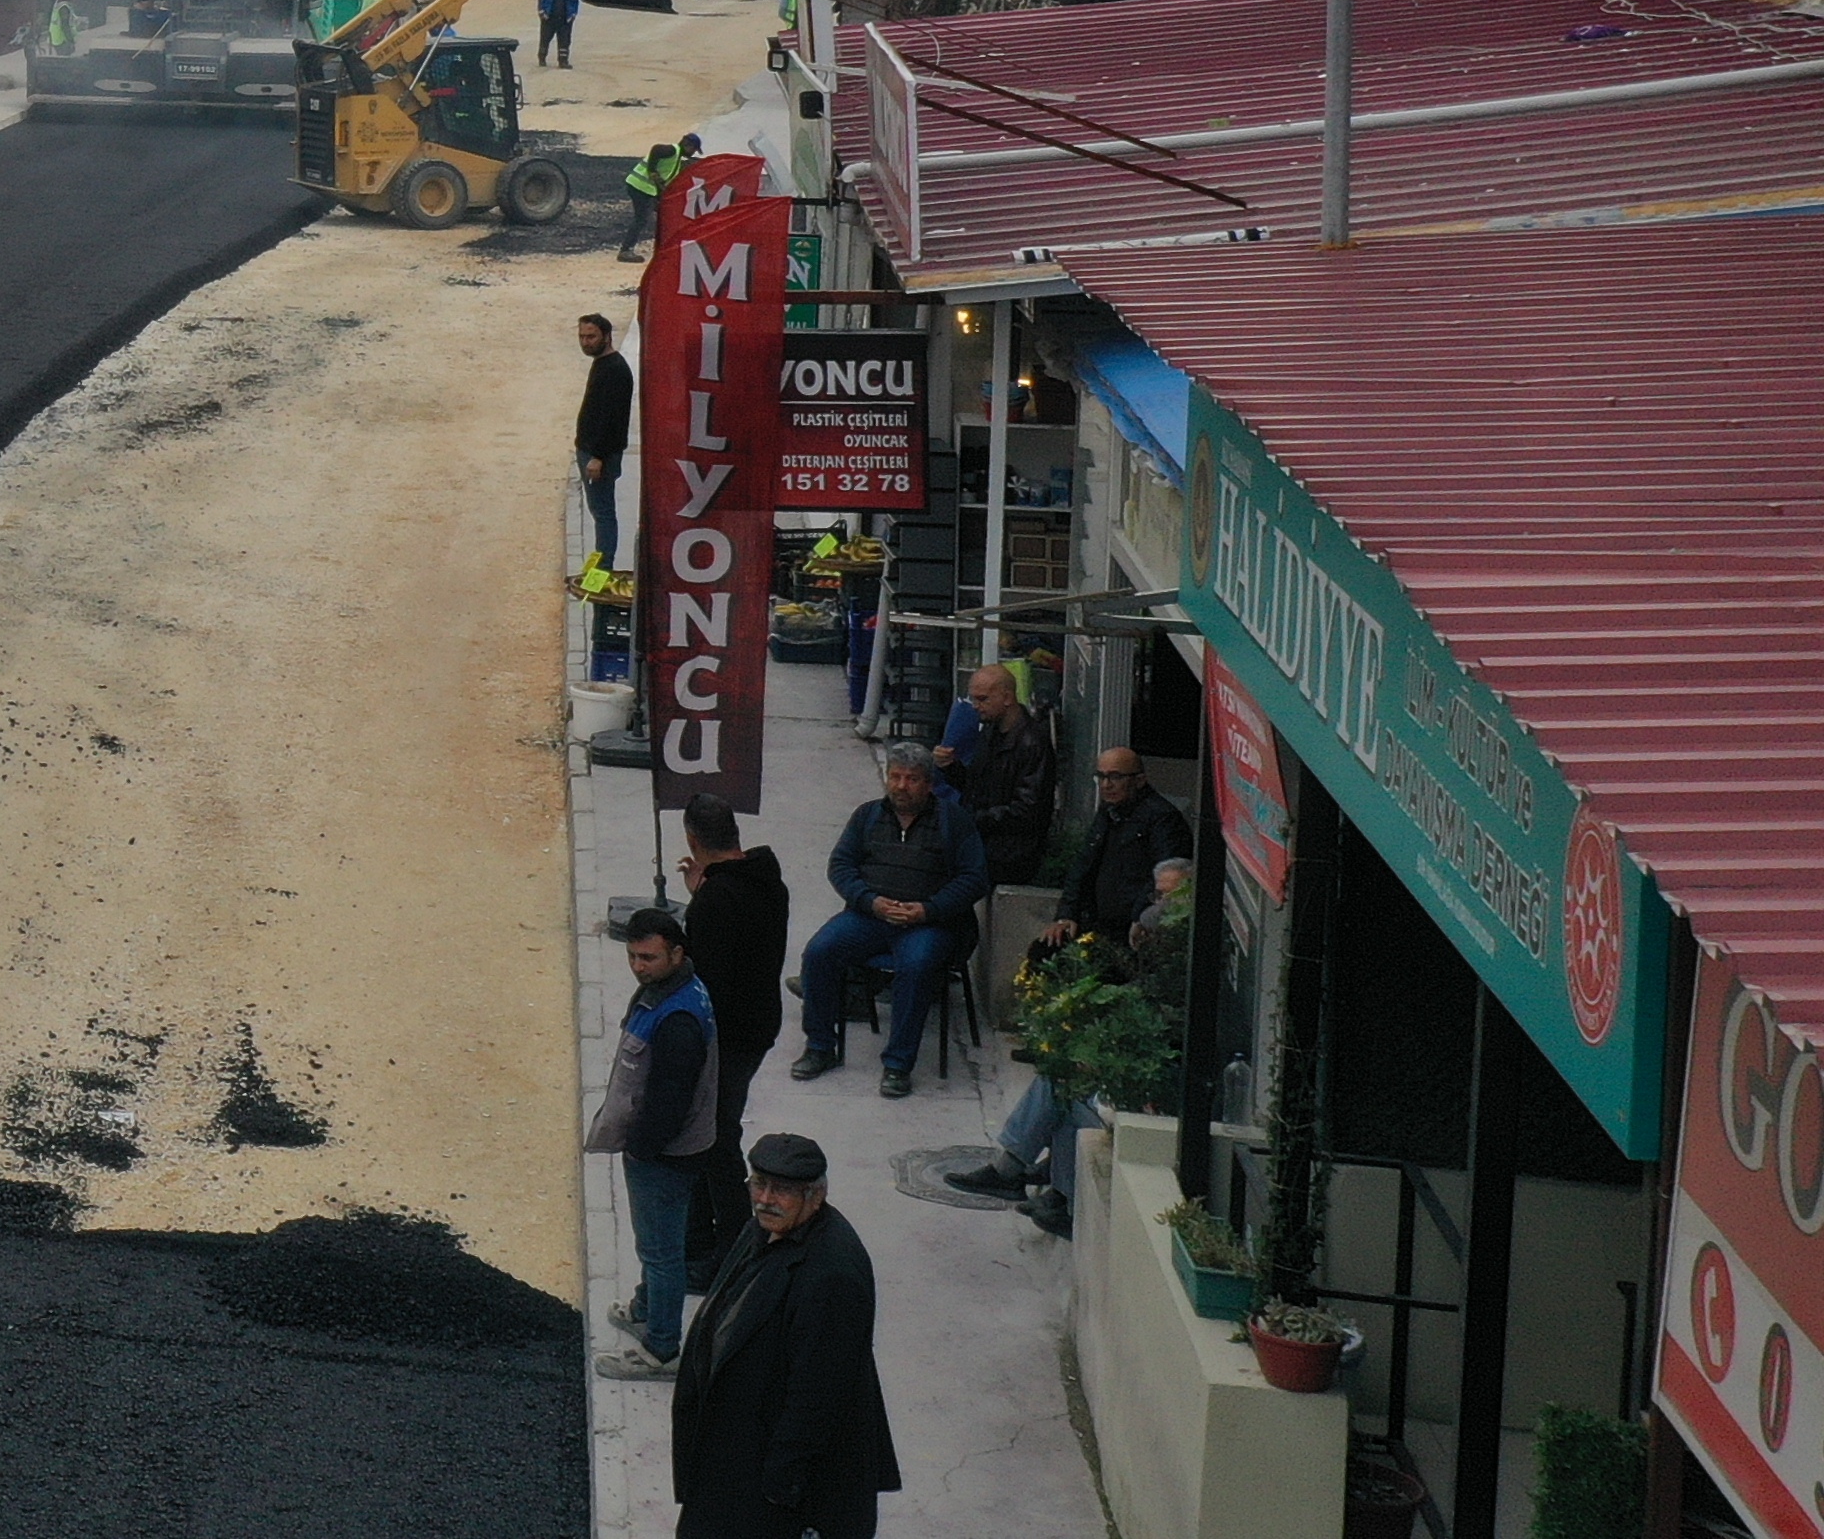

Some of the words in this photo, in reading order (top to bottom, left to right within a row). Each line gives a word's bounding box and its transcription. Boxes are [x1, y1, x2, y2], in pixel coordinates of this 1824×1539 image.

[793, 410, 844, 426] PLASTİK
[847, 410, 908, 431] ÇEŞİTLERİ
[844, 435, 909, 448] OYUNCAK
[782, 455, 845, 470] DETERJAN
[848, 453, 909, 472] ÇEŞİTLERİ
[837, 474, 869, 492] 32
[878, 474, 910, 492] 78
[663, 240, 752, 776] MİLYONCU
